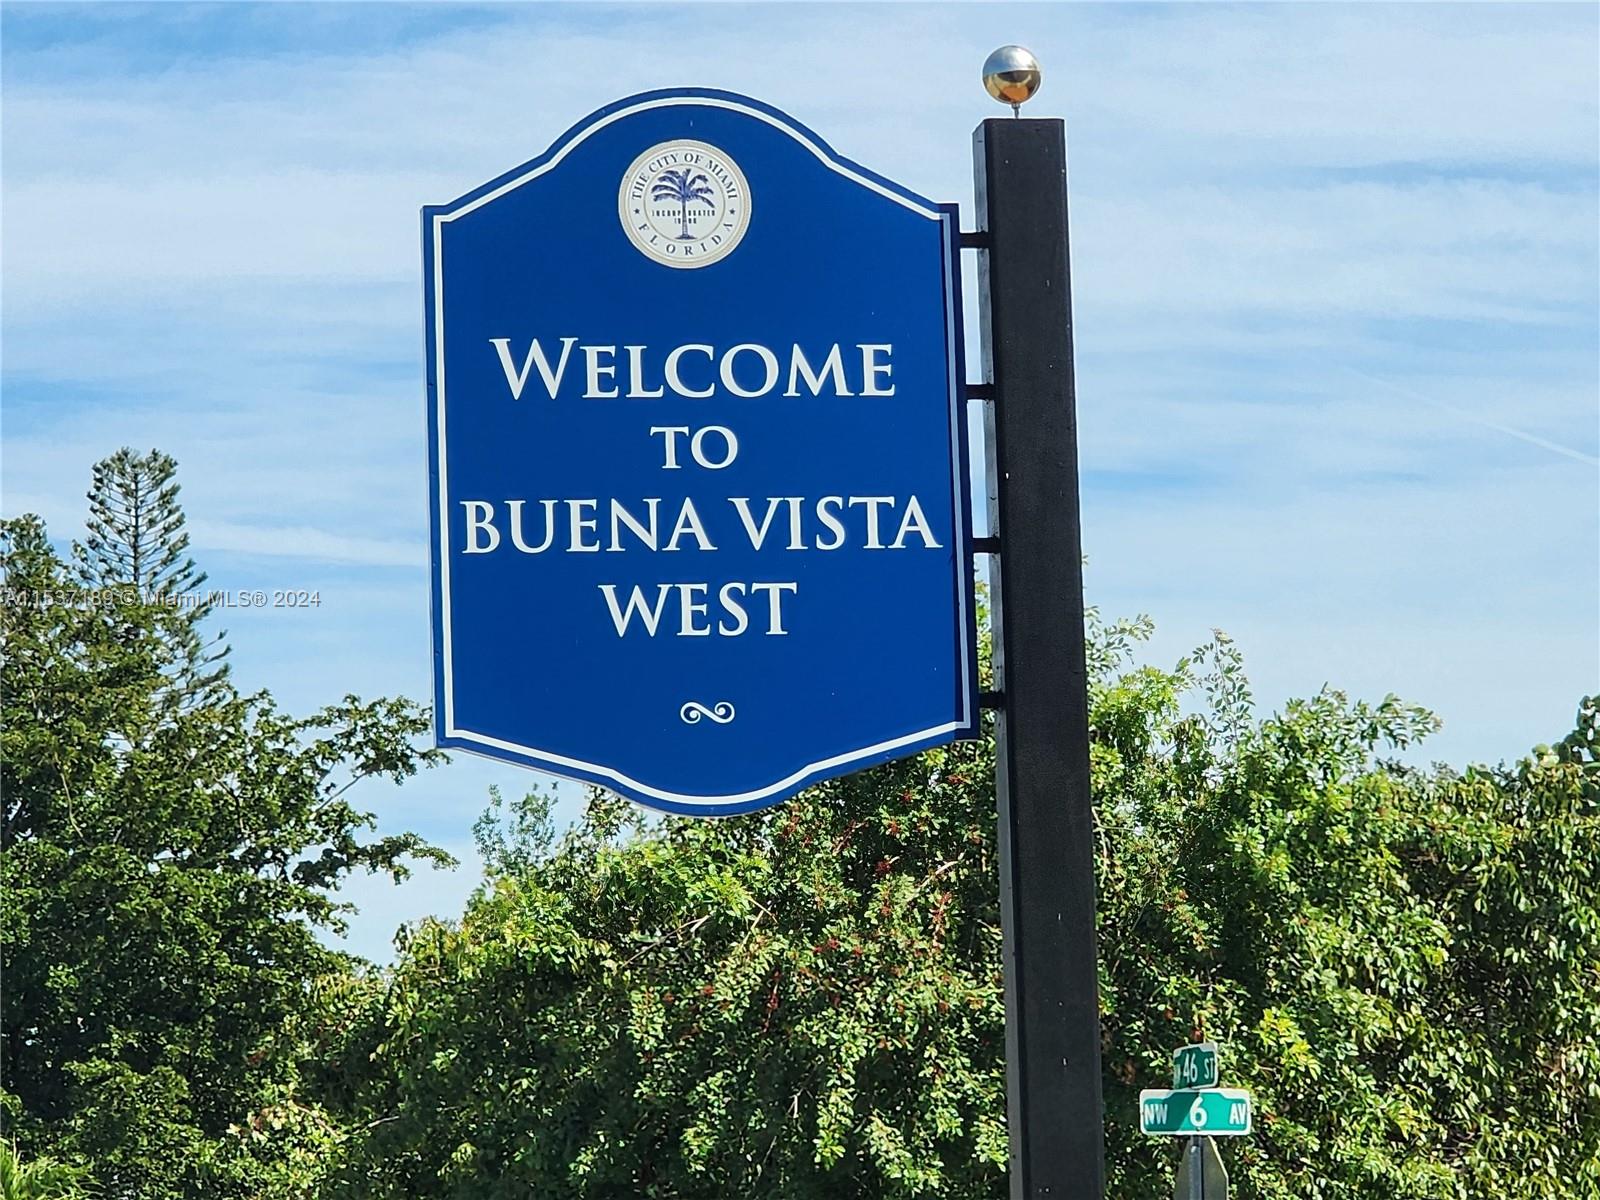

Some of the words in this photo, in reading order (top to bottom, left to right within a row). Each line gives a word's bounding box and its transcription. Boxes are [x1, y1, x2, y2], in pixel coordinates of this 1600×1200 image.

[632, 172, 649, 200] THE
[649, 153, 679, 173] CITY
[684, 152, 704, 164] OF
[705, 160, 738, 199] MIAMI
[638, 222, 734, 256] FLORIDA
[649, 425, 739, 470] TO
[459, 496, 718, 555] BUENA
[727, 494, 944, 552] VISTA
[597, 581, 798, 638] WEST
[1183, 1053, 1198, 1083] 46
[1204, 1057, 1215, 1080] ST
[1144, 1103, 1169, 1126] NW
[1189, 1095, 1208, 1128] 6
[1229, 1103, 1247, 1125] AV
